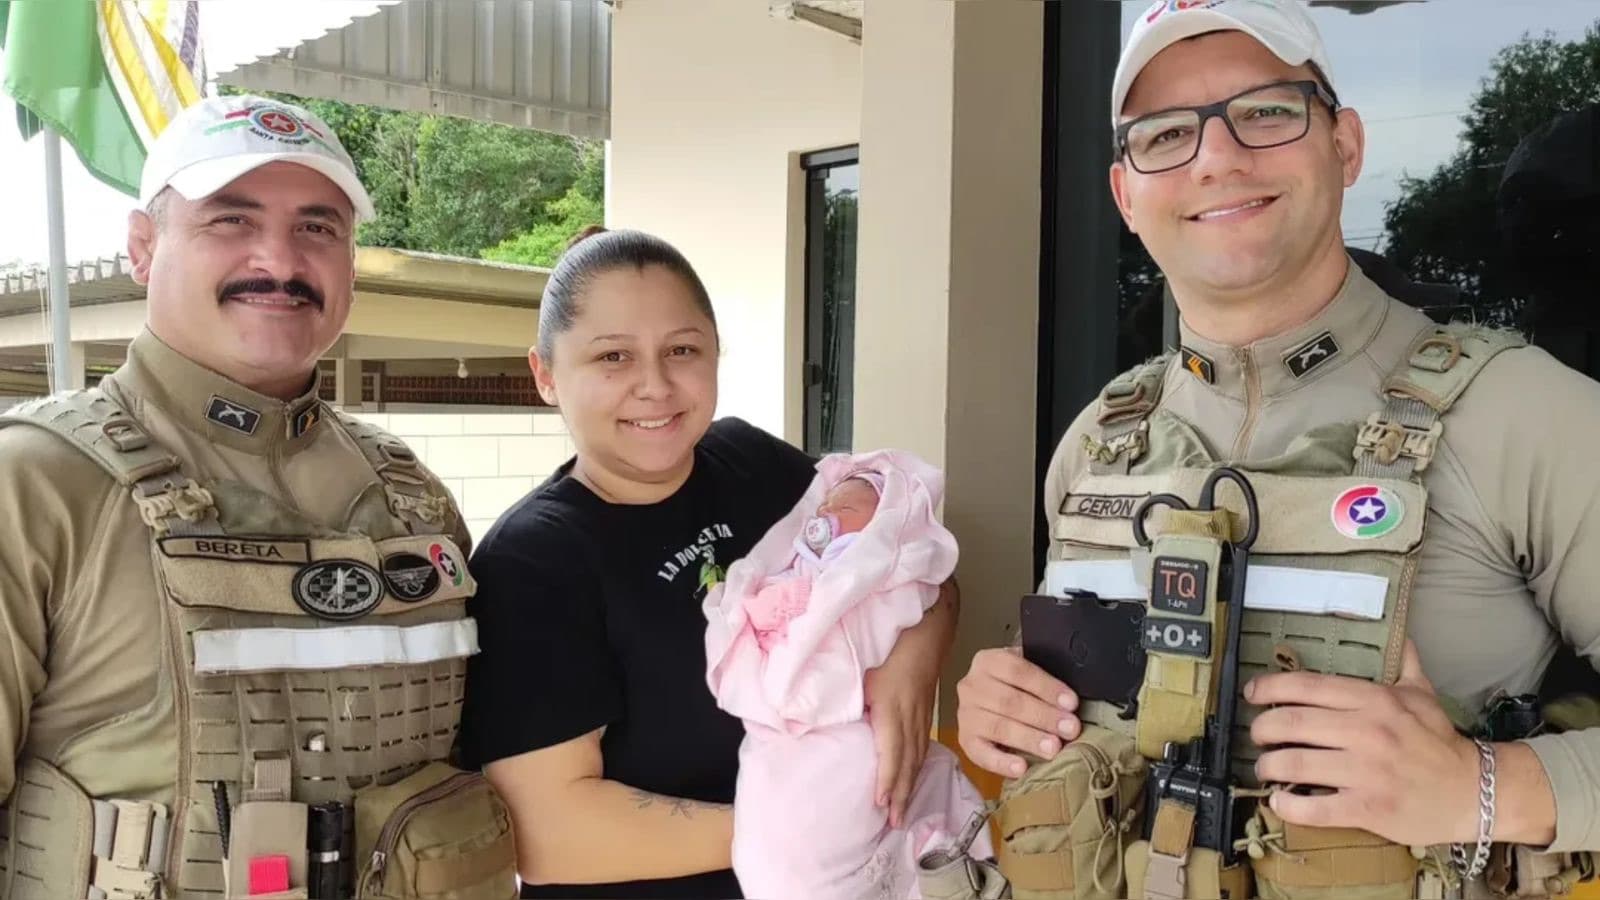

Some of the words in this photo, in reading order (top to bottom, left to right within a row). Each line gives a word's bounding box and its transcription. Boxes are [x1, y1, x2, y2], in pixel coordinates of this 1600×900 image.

[1079, 497, 1136, 516] CERON
[195, 540, 284, 559] BERETA
[657, 561, 680, 582] LA
[1160, 569, 1196, 599] TQ
